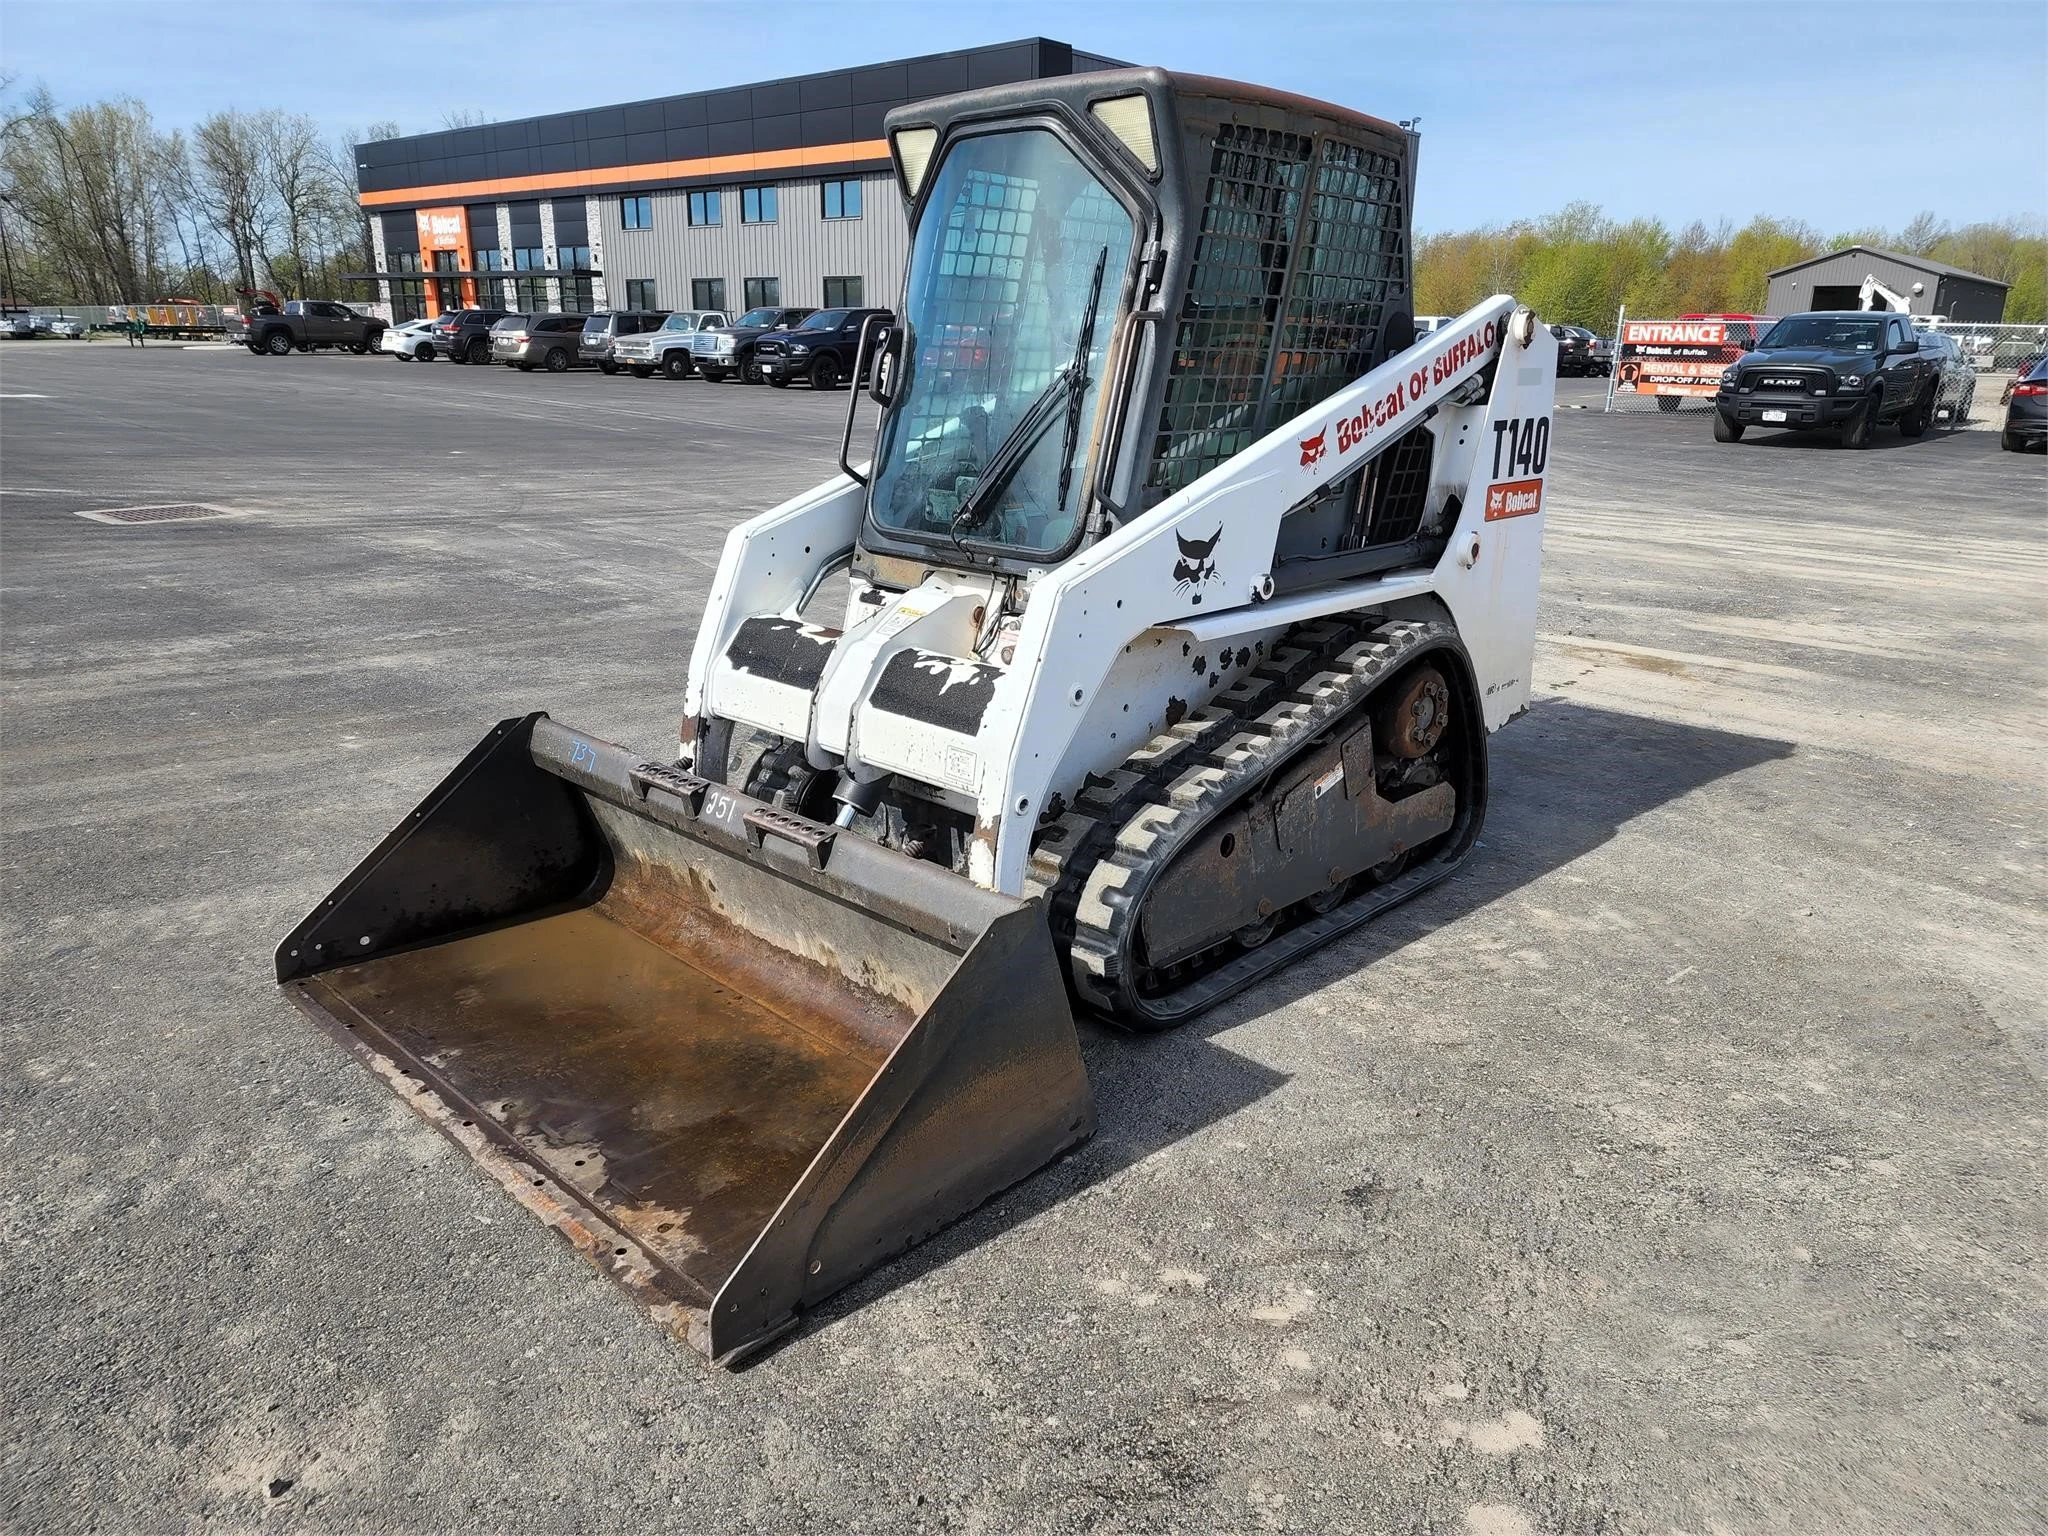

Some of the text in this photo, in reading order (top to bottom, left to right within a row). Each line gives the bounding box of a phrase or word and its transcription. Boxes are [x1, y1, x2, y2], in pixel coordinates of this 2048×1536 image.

[1628, 324, 1721, 342] ENTRANCE
[1673, 348, 1681, 356] of
[1682, 348, 1708, 356] Buffalo
[1643, 363, 1685, 374] RENTAL
[1688, 364, 1697, 375] &
[1650, 375, 1694, 384] DROP-OFF
[1336, 320, 1495, 454] Bobcat OF BUFFALO
[1492, 416, 1550, 480] T140
[1505, 488, 1538, 513] Bobcat
[705, 792, 737, 823] 251
